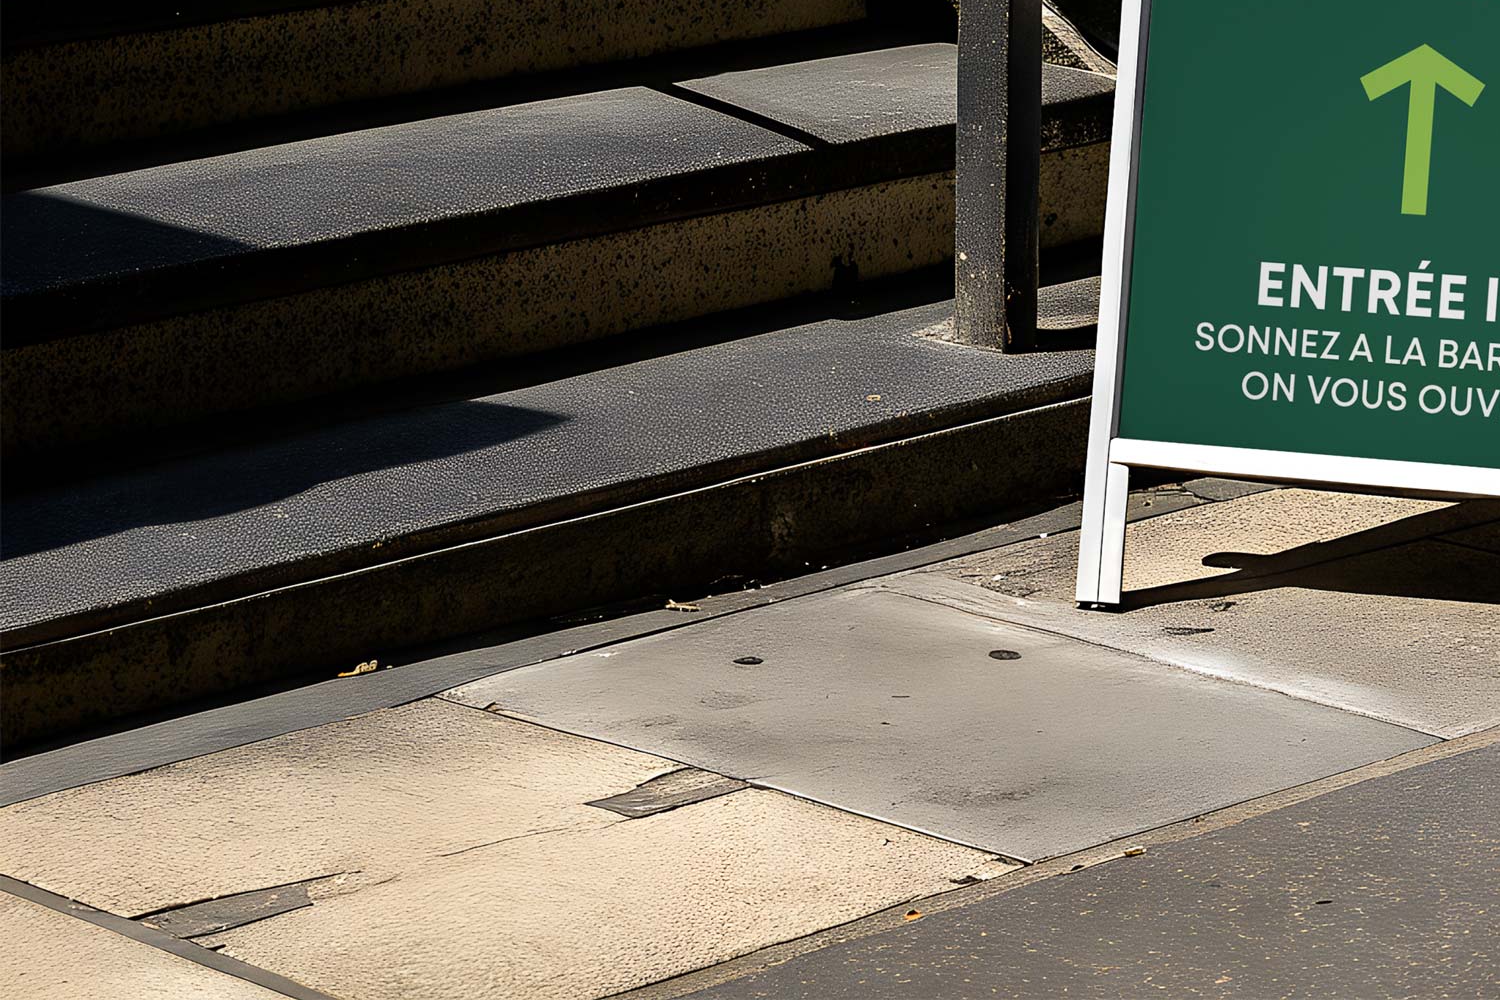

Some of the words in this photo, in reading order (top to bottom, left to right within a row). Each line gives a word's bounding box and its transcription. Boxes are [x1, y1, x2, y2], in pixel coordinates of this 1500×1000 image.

[1257, 259, 1468, 320] ENTRÉE
[1194, 321, 1341, 360] SONNEZ
[1348, 333, 1374, 363] A
[1384, 335, 1427, 367] LA
[1241, 371, 1296, 403] ON
[1307, 374, 1407, 412] VOUS
